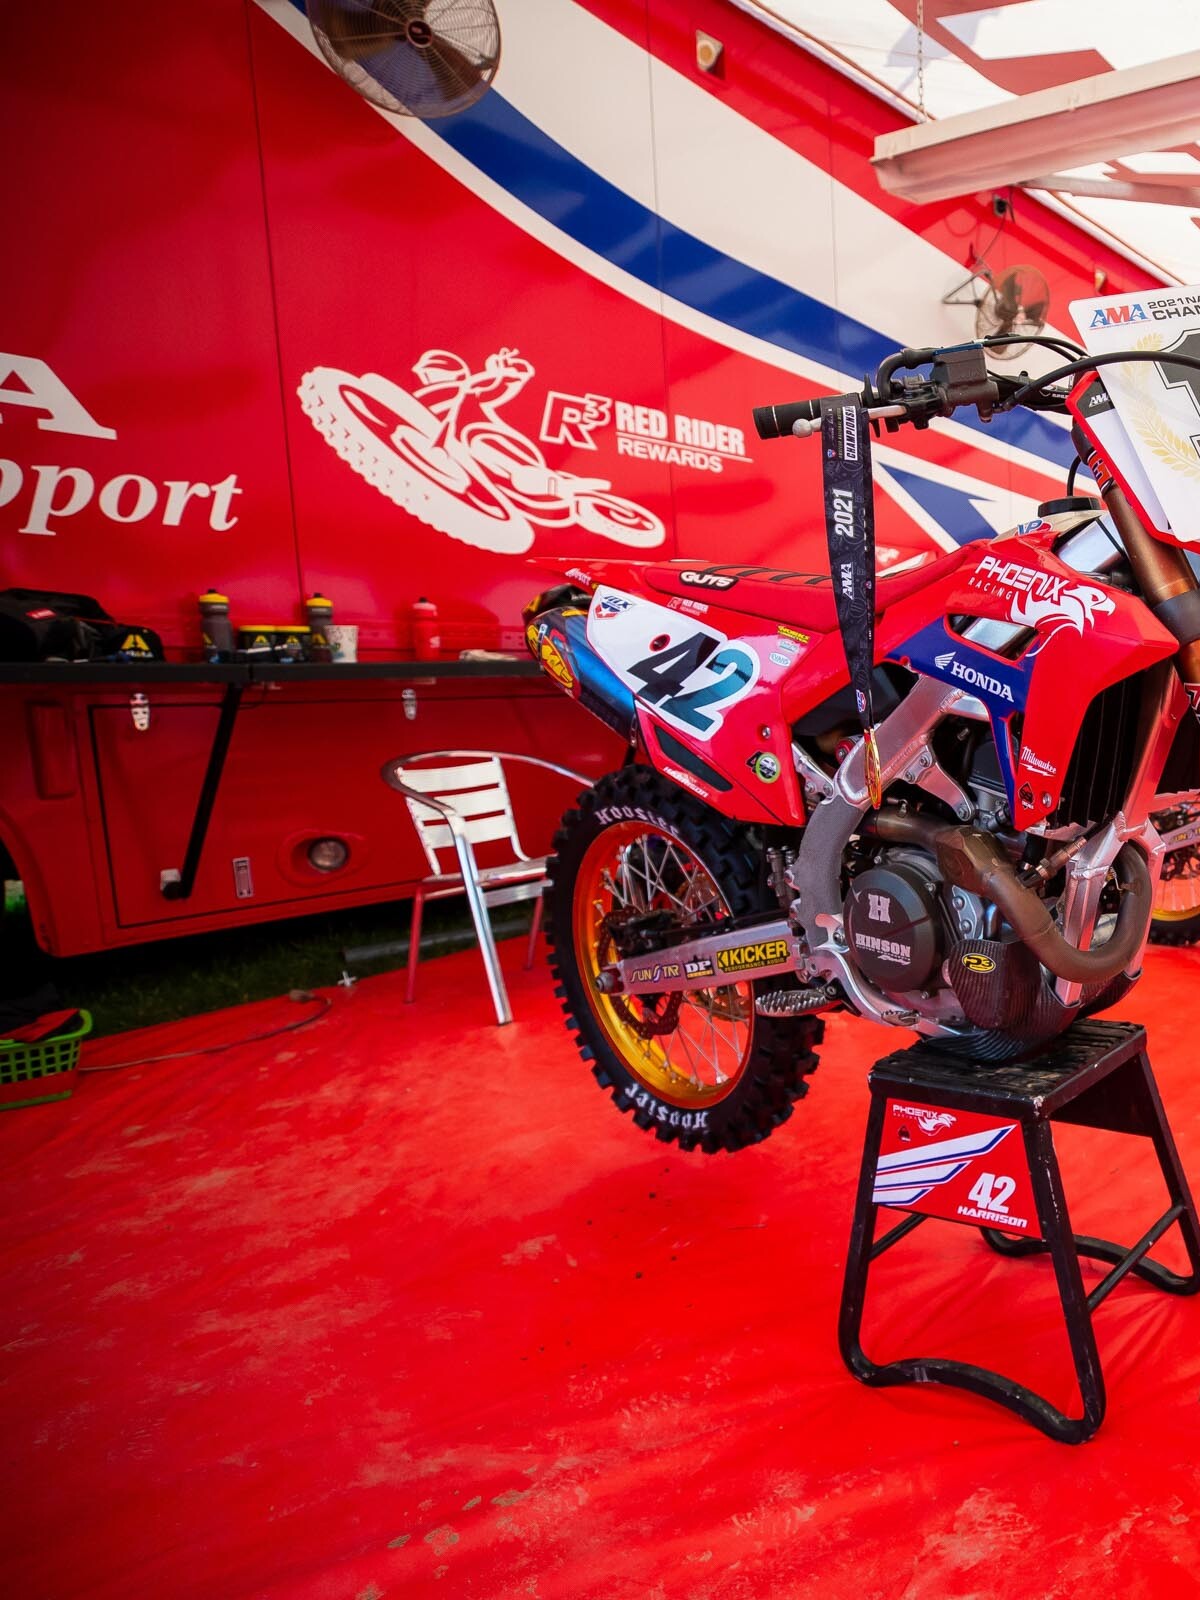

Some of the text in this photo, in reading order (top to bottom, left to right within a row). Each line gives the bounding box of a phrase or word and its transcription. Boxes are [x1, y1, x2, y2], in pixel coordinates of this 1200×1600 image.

[1089, 303, 1149, 329] AMA
[1147, 298, 1184, 309] 2021
[0, 352, 117, 440] A
[614, 400, 746, 456] RED RIDER
[617, 437, 723, 473] REWARDS
[832, 488, 855, 538] 2021
[680, 571, 734, 588] GUTS
[967, 577, 1017, 601] RACING
[974, 555, 1069, 606] PHOENIX
[626, 631, 754, 733] 42
[950, 660, 1015, 704] HONDA
[1020, 745, 1057, 774] Milwaukee
[868, 893, 891, 924] H
[729, 940, 789, 966] KICKER
[855, 932, 912, 958] HINSON
[892, 1104, 939, 1120] PHOENIX
[968, 1172, 1017, 1214] 42
[957, 1206, 1028, 1229] HARRISON
